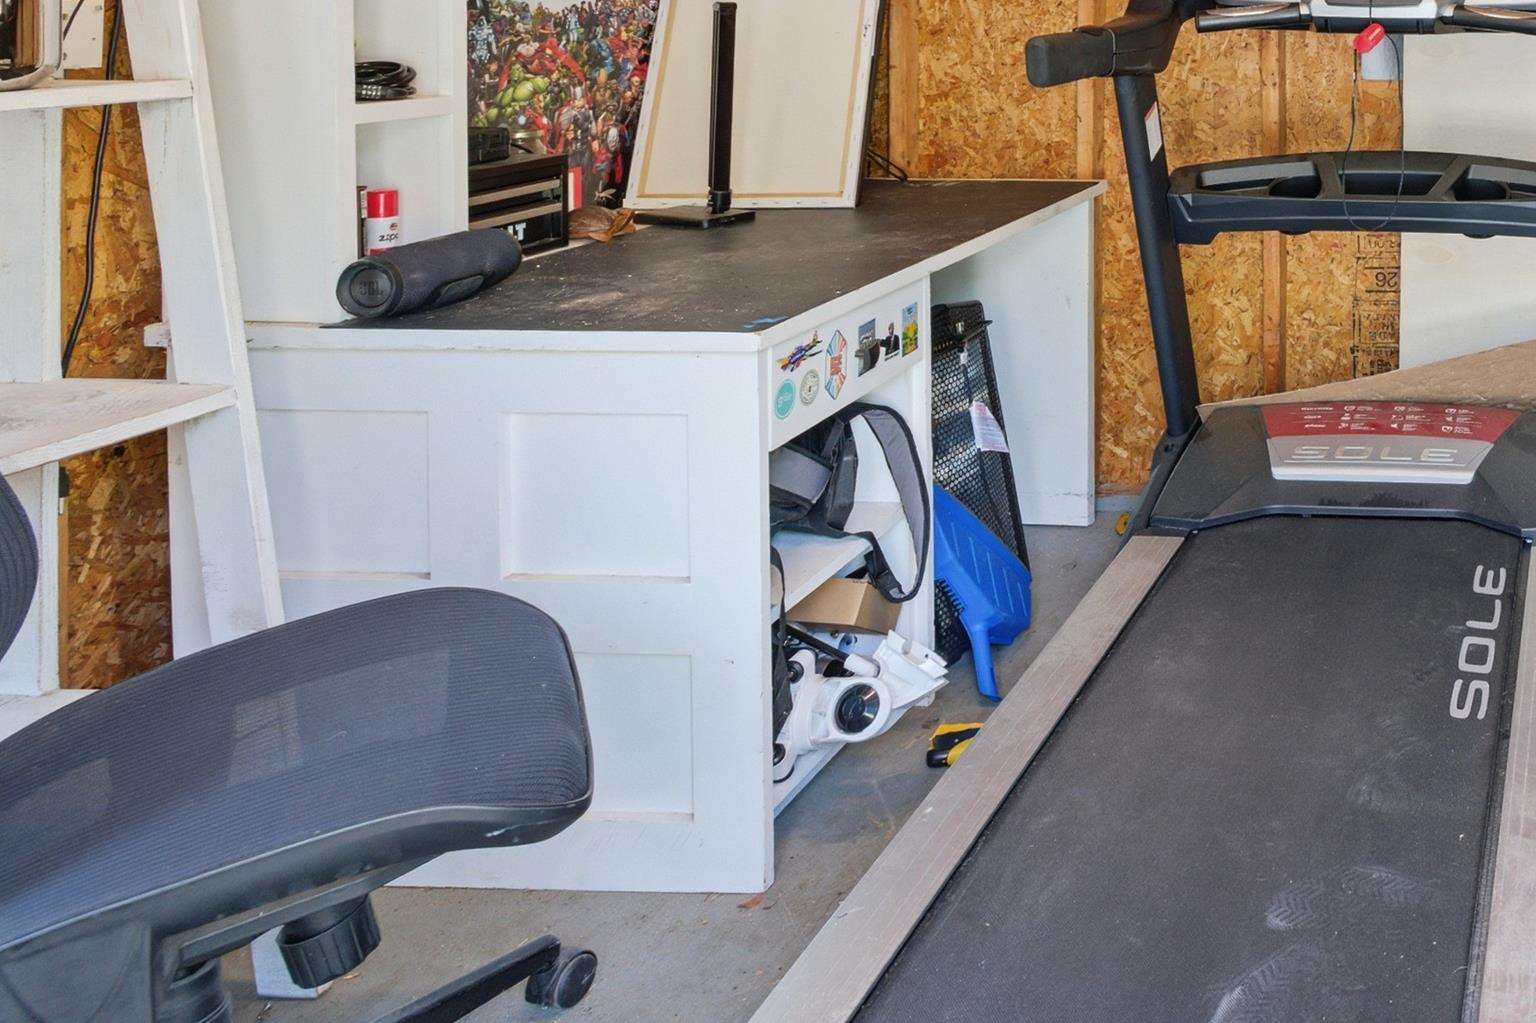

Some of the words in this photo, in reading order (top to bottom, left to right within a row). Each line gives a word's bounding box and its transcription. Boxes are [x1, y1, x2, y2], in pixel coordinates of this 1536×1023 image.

[1375, 271, 1398, 287] 26
[1292, 445, 1458, 463] SOLE
[1449, 564, 1507, 720] SOLE
